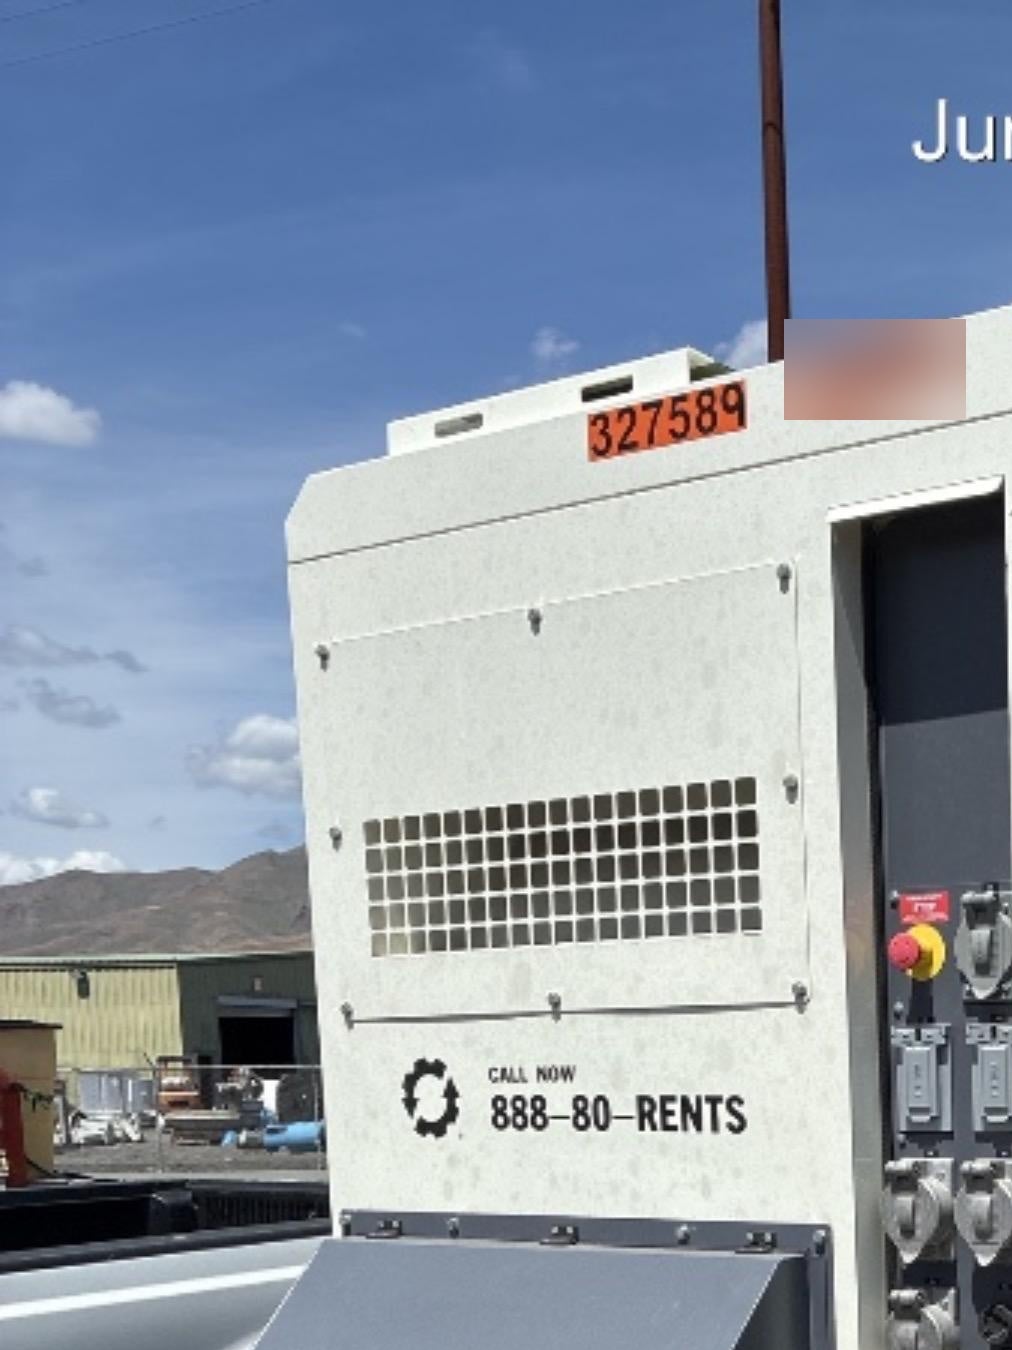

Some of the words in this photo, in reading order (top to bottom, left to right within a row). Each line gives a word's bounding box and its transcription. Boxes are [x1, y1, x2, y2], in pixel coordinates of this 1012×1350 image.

[590, 381, 747, 456] 327589
[488, 1066, 529, 1084] CALL
[535, 1065, 577, 1084] NOW
[490, 1093, 748, 1135] 888-80-RENTS
